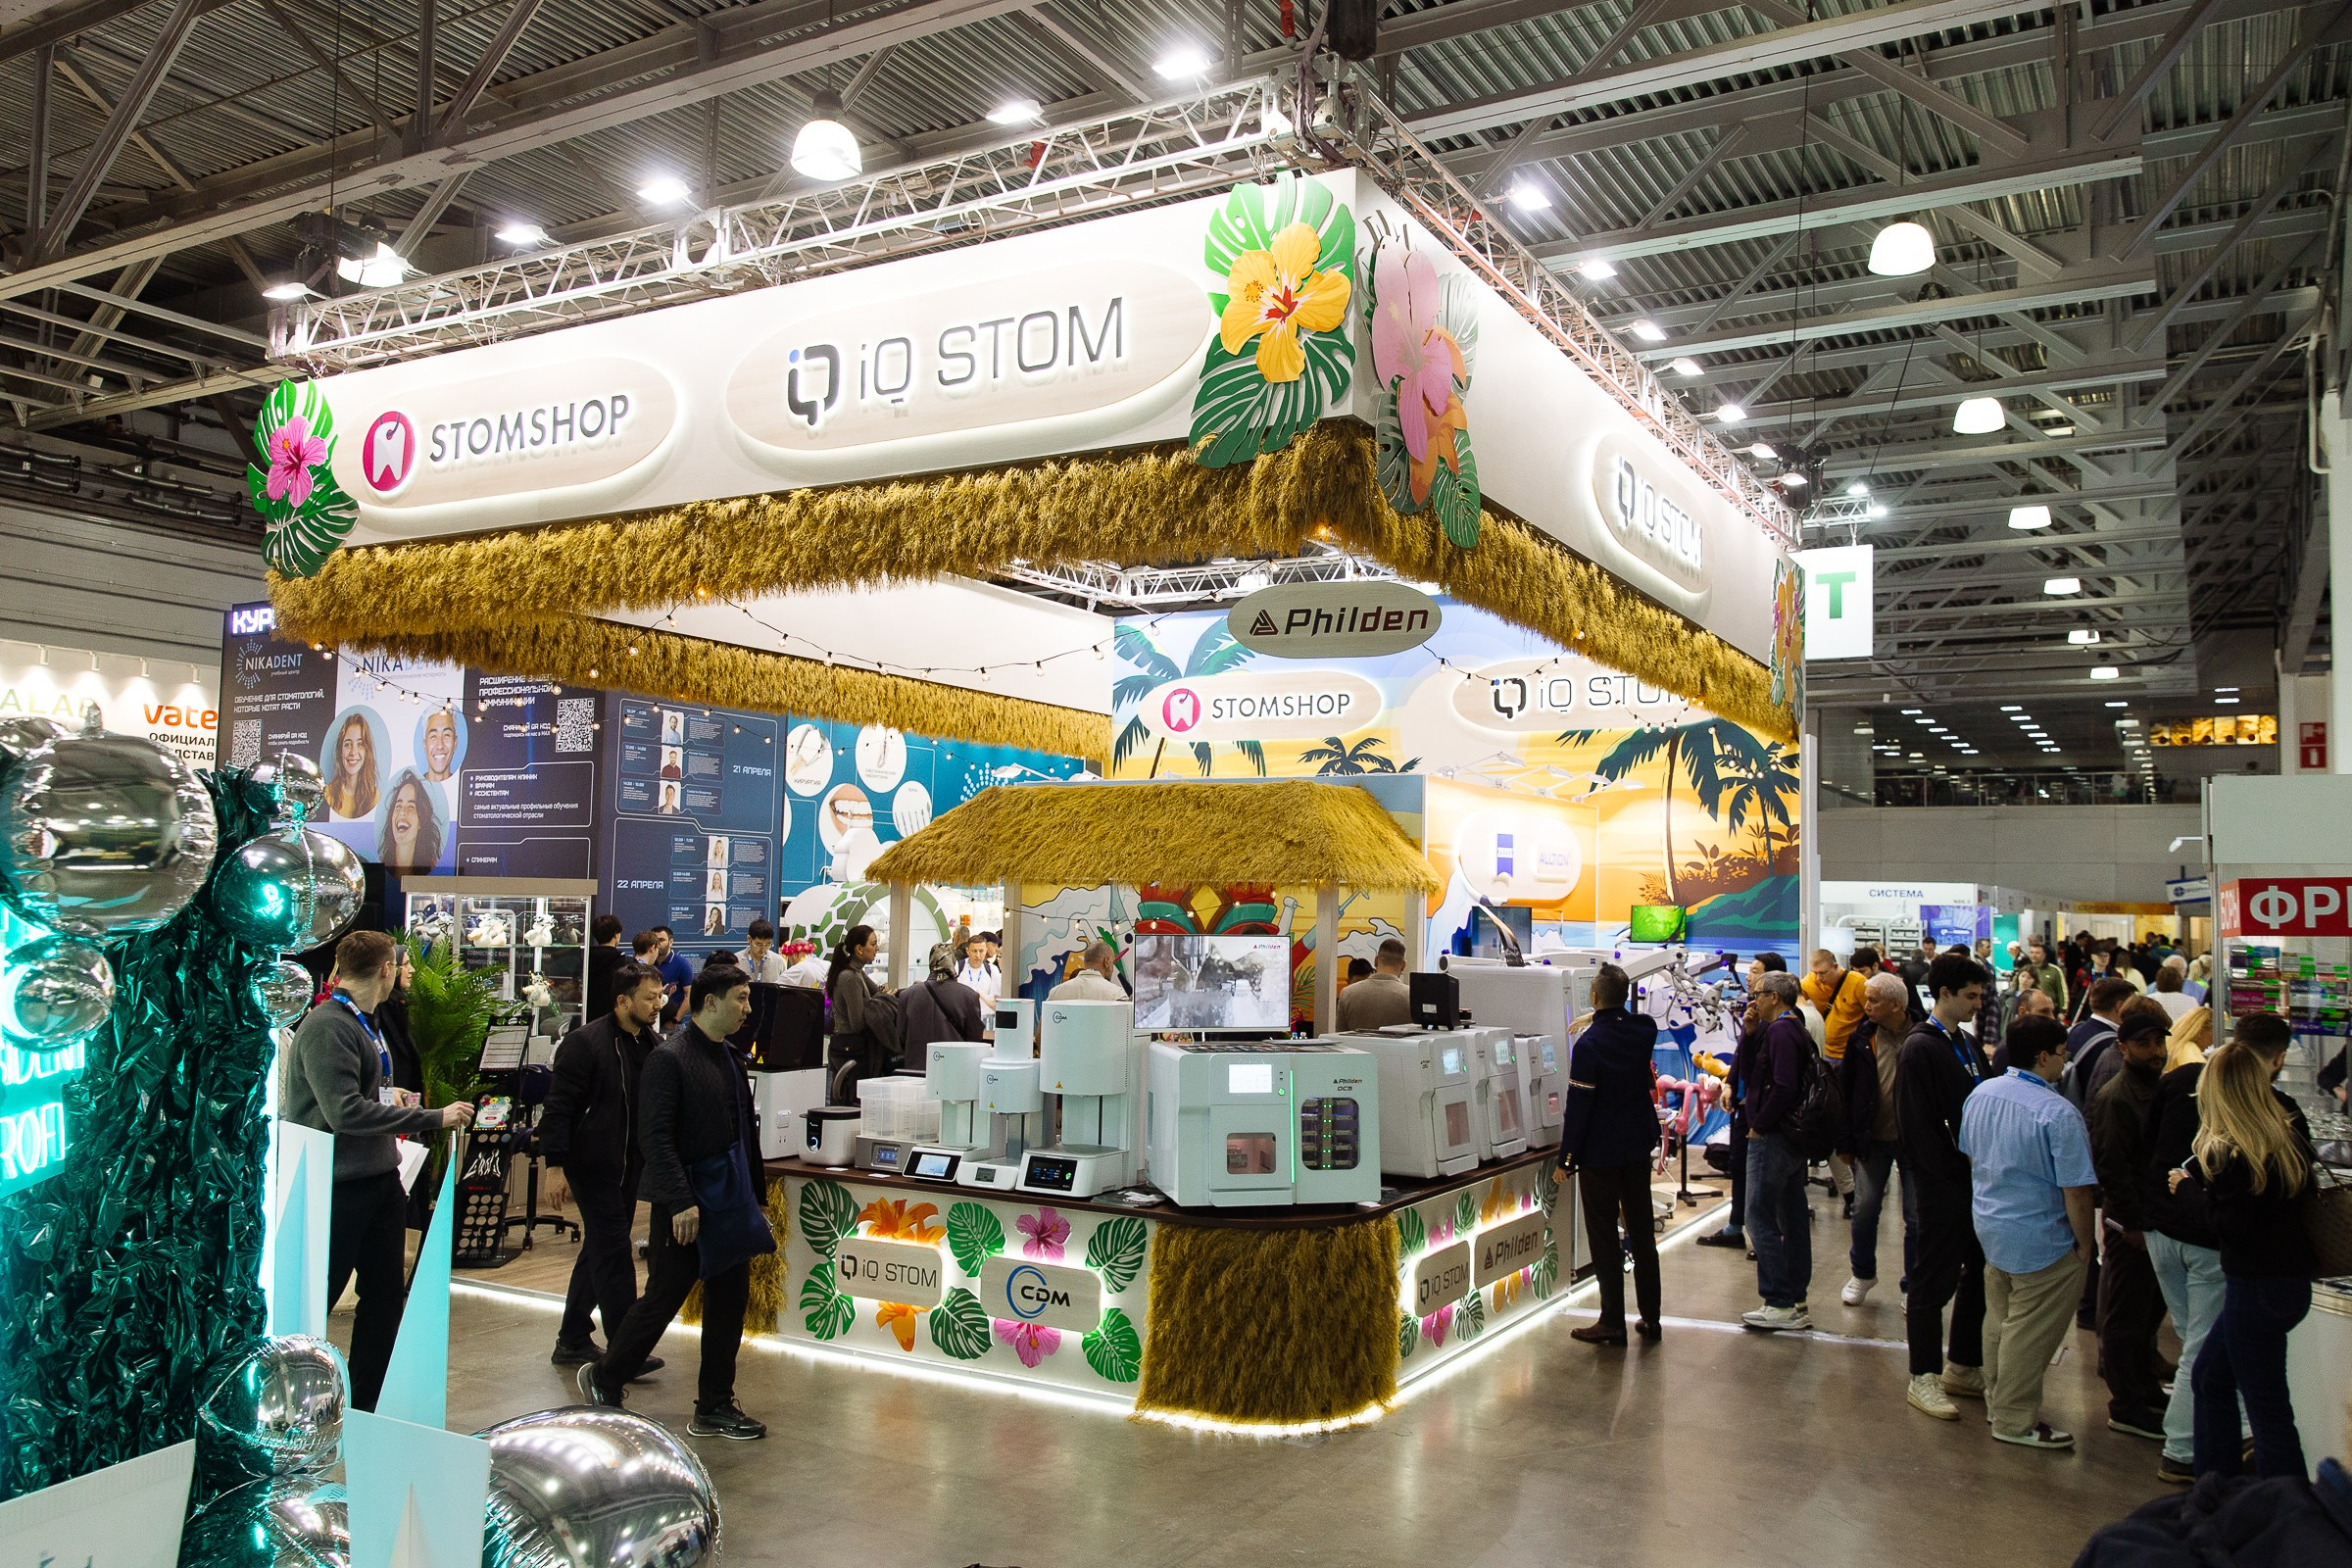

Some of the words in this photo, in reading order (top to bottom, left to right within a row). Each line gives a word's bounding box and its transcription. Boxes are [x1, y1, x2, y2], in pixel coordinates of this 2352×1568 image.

[860, 337, 911, 404] iQ
[938, 297, 1123, 386] STOM
[429, 394, 630, 463] STOMSHOP
[1661, 497, 1703, 568] STOM
[1284, 606, 1429, 637] Philden
[245, 654, 303, 672] NIKADENT
[479, 674, 526, 686] РАСШИРЕНИЕ
[234, 704, 261, 713] КОТОРЫЕ
[280, 702, 301, 710] РАСТИ
[235, 694, 264, 704] ОБУЧЕНИЕ
[265, 693, 276, 703] ДЛЯ
[1211, 694, 1350, 719] STOMSHOP
[1541, 678, 1572, 712] iQ
[143, 704, 218, 729] vate
[149, 732, 215, 746] ОФИЦИАЛ
[733, 764, 741, 773] 21
[742, 766, 772, 777] АПРЕЛЯ
[553, 802, 578, 811] обучения
[616, 879, 628, 889] 22
[630, 880, 664, 890] АПРЕЛЯ
[1869, 889, 1924, 899] СИСТЕМА
[2249, 885, 2352, 930] ФР
[1494, 1231, 1538, 1266] Philden
[862, 1258, 879, 1283] iQ
[885, 1262, 938, 1289] STOM
[1443, 1261, 1469, 1290] STOM
[1020, 1285, 1070, 1307] CDM
